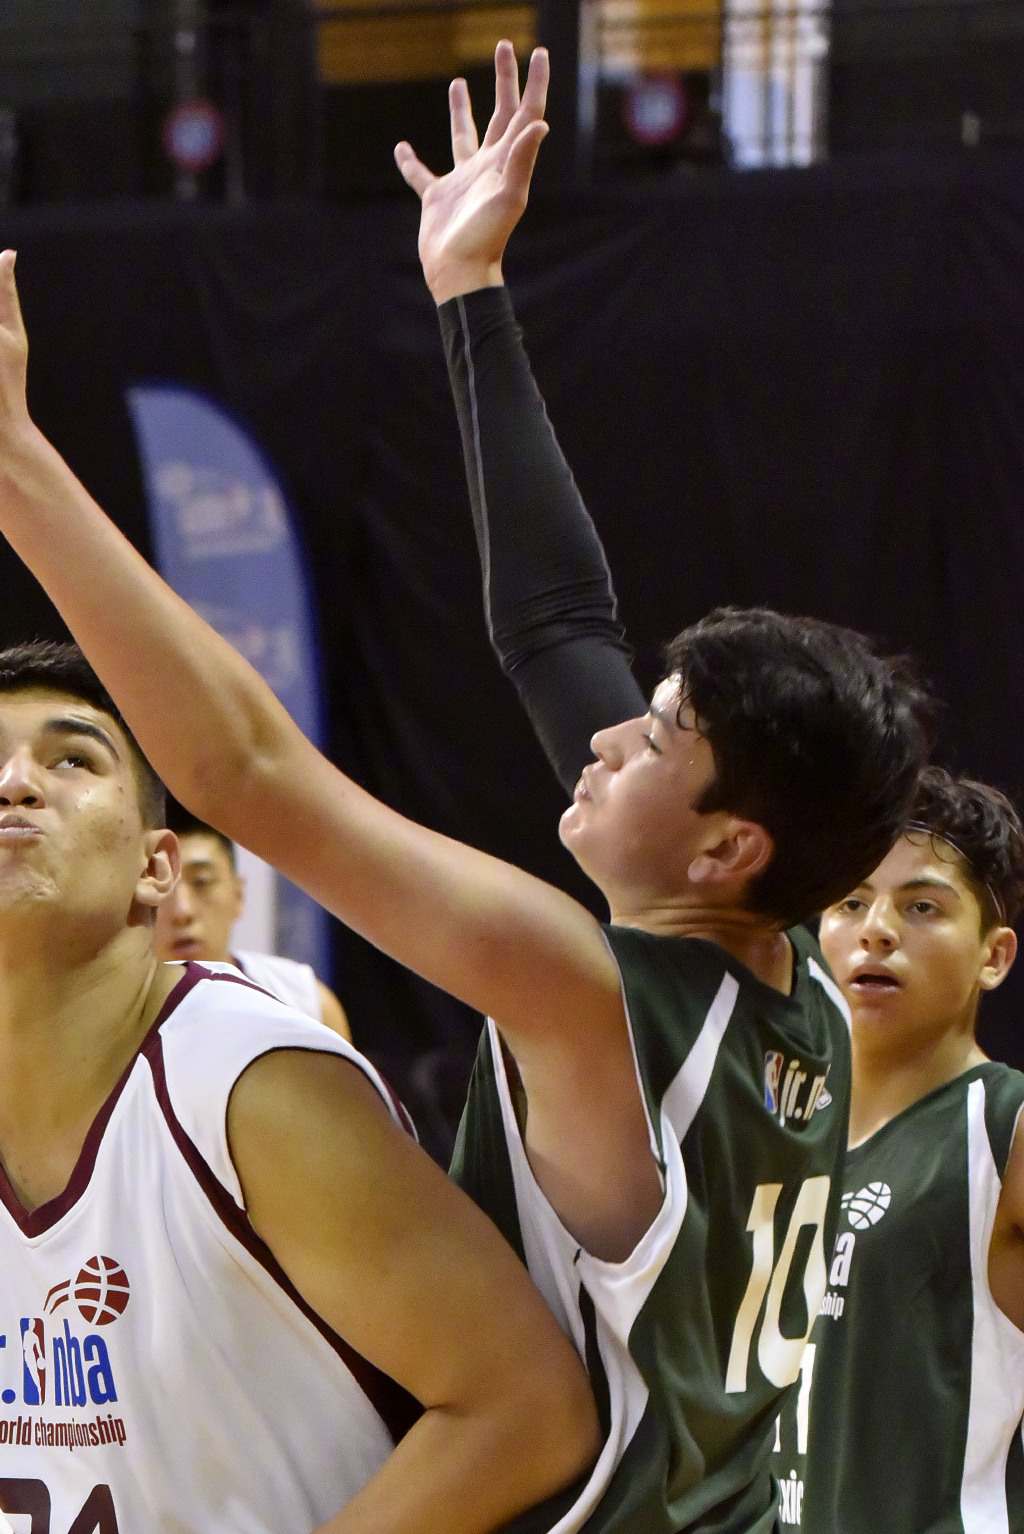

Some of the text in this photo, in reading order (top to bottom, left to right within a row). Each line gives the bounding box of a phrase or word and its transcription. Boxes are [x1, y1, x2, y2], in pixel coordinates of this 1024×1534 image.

[725, 1175, 830, 1393] 10
[52, 1318, 119, 1407] nba
[35, 1414, 127, 1452] championship
